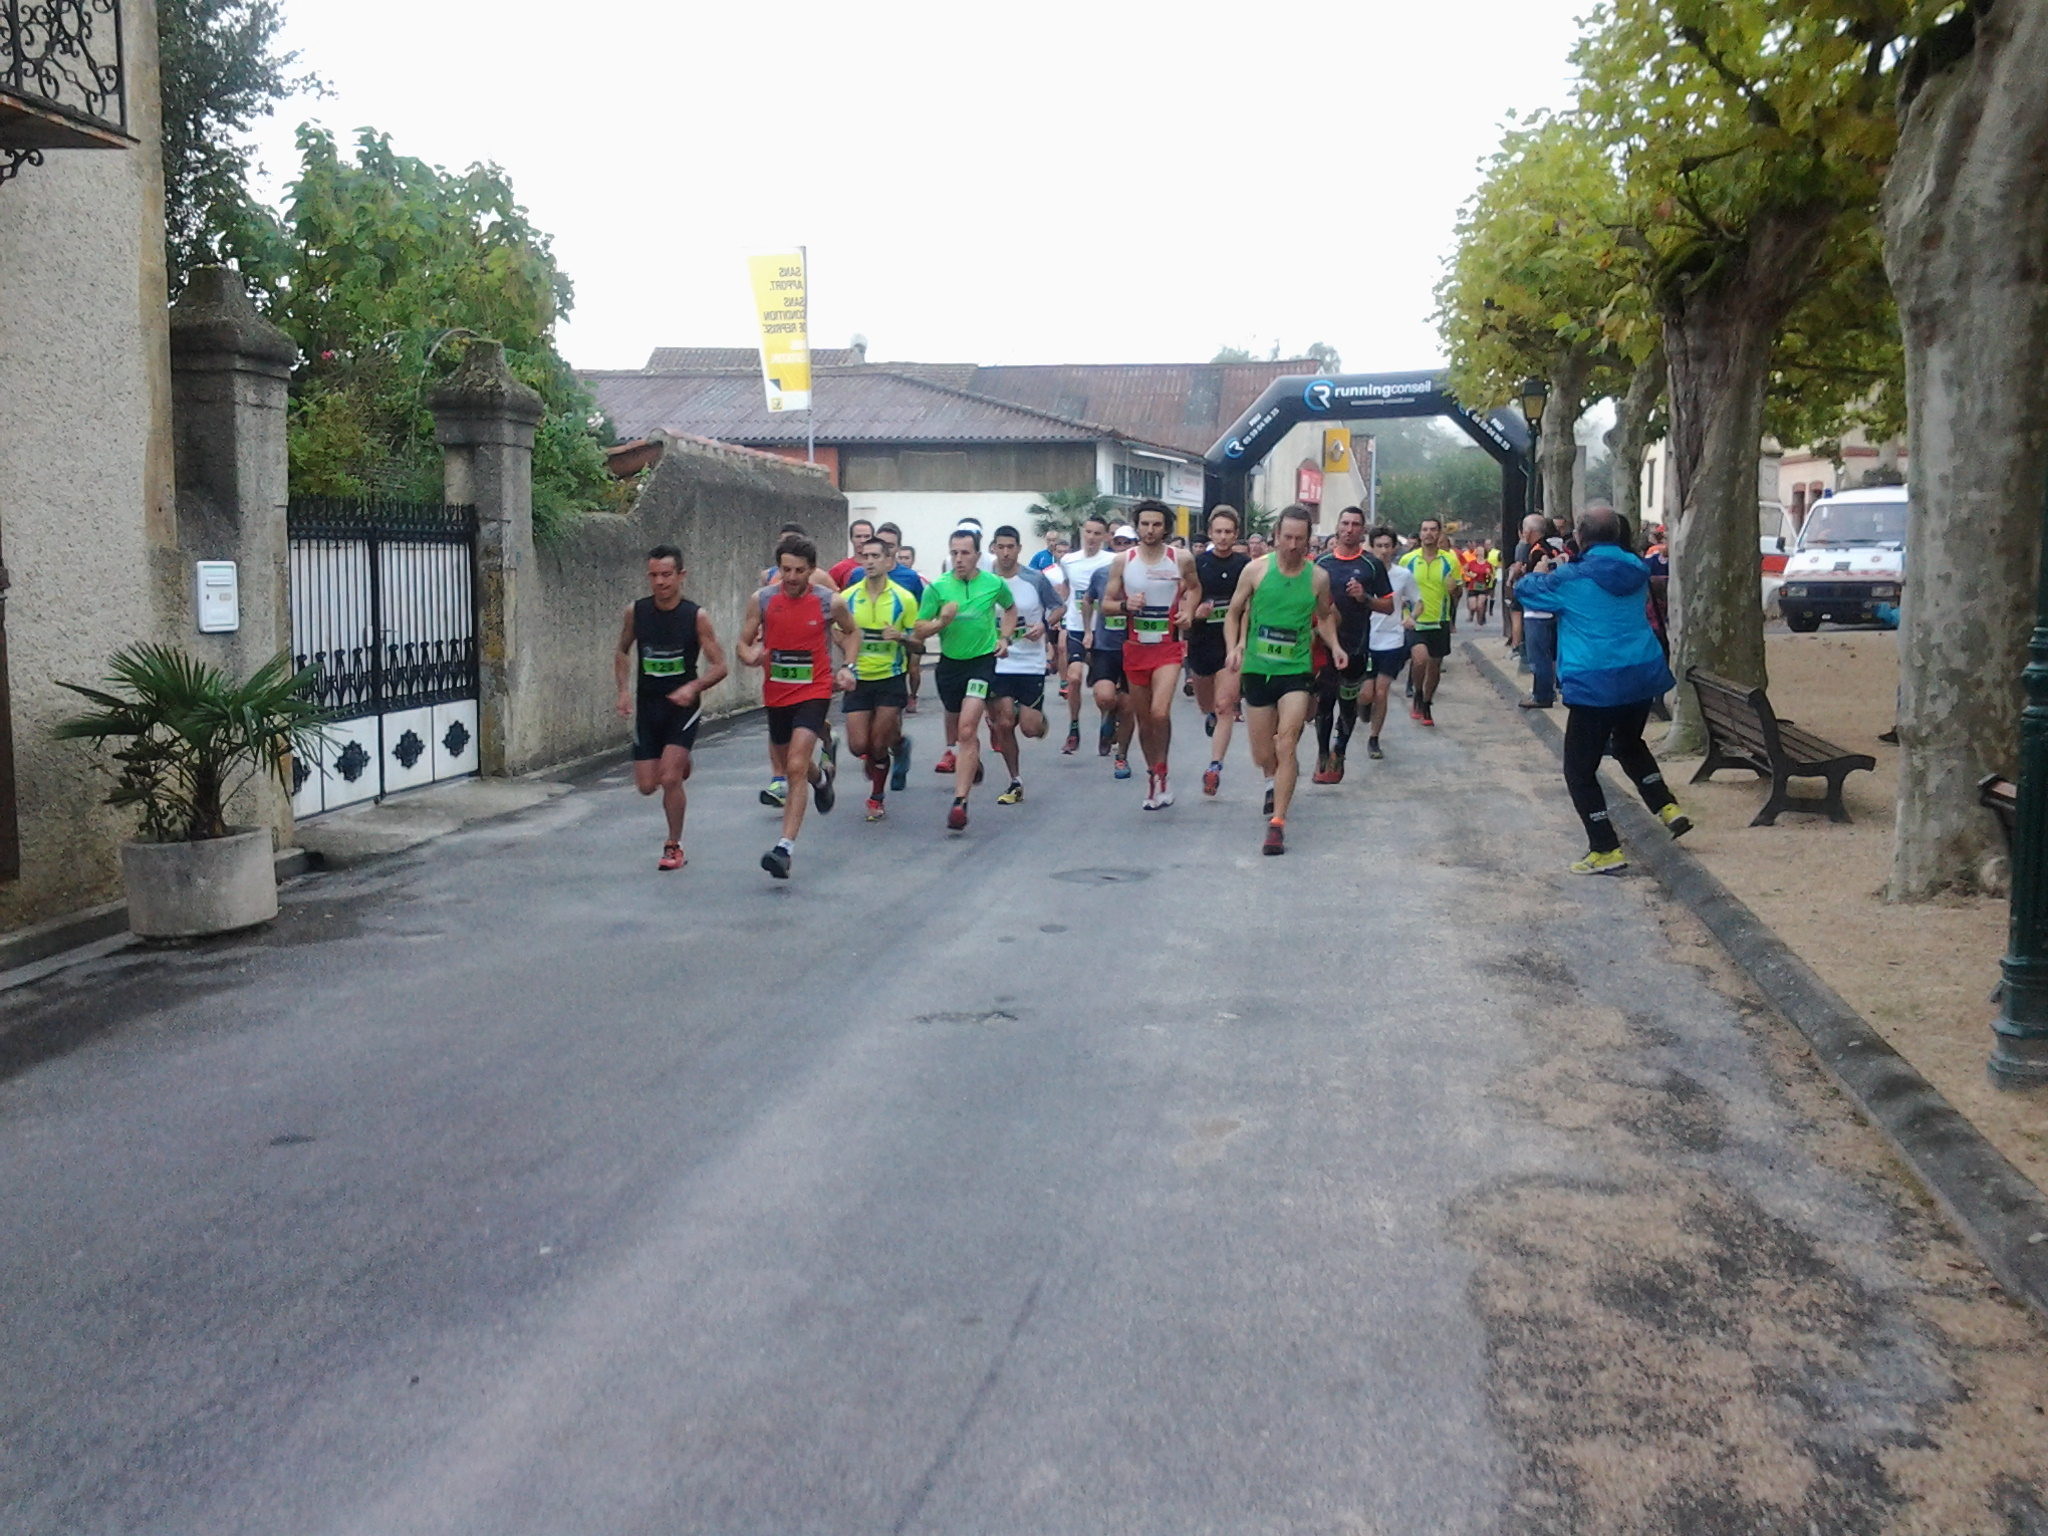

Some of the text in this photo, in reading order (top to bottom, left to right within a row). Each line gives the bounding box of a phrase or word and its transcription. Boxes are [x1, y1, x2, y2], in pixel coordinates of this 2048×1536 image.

[1334, 380, 1432, 398] runningconseil
[1213, 609, 1228, 619] 12
[1142, 621, 1157, 630] 96
